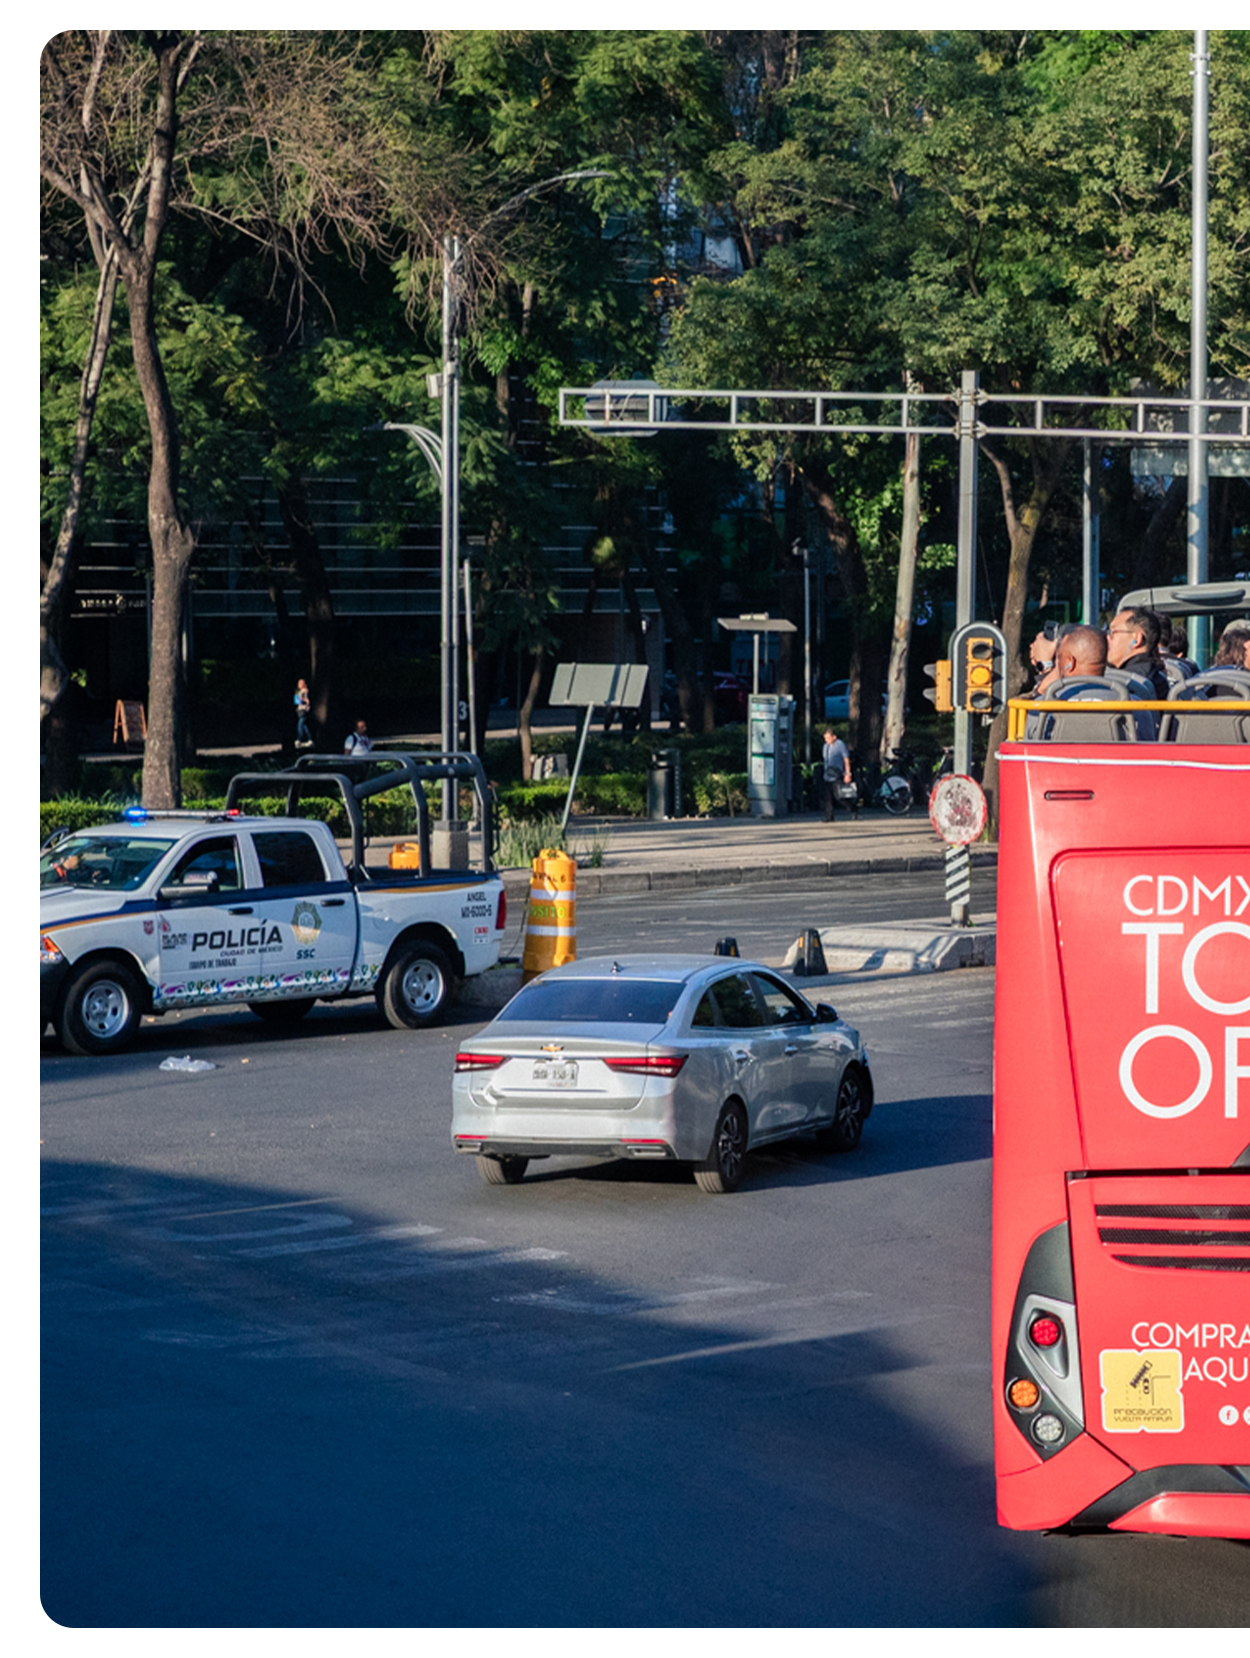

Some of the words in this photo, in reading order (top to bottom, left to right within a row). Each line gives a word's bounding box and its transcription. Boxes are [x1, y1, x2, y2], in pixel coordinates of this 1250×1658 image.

[191, 919, 283, 951] POLICÍA
[220, 948, 245, 957] CIUDAD
[247, 947, 256, 955] DE
[296, 949, 315, 959] SSC
